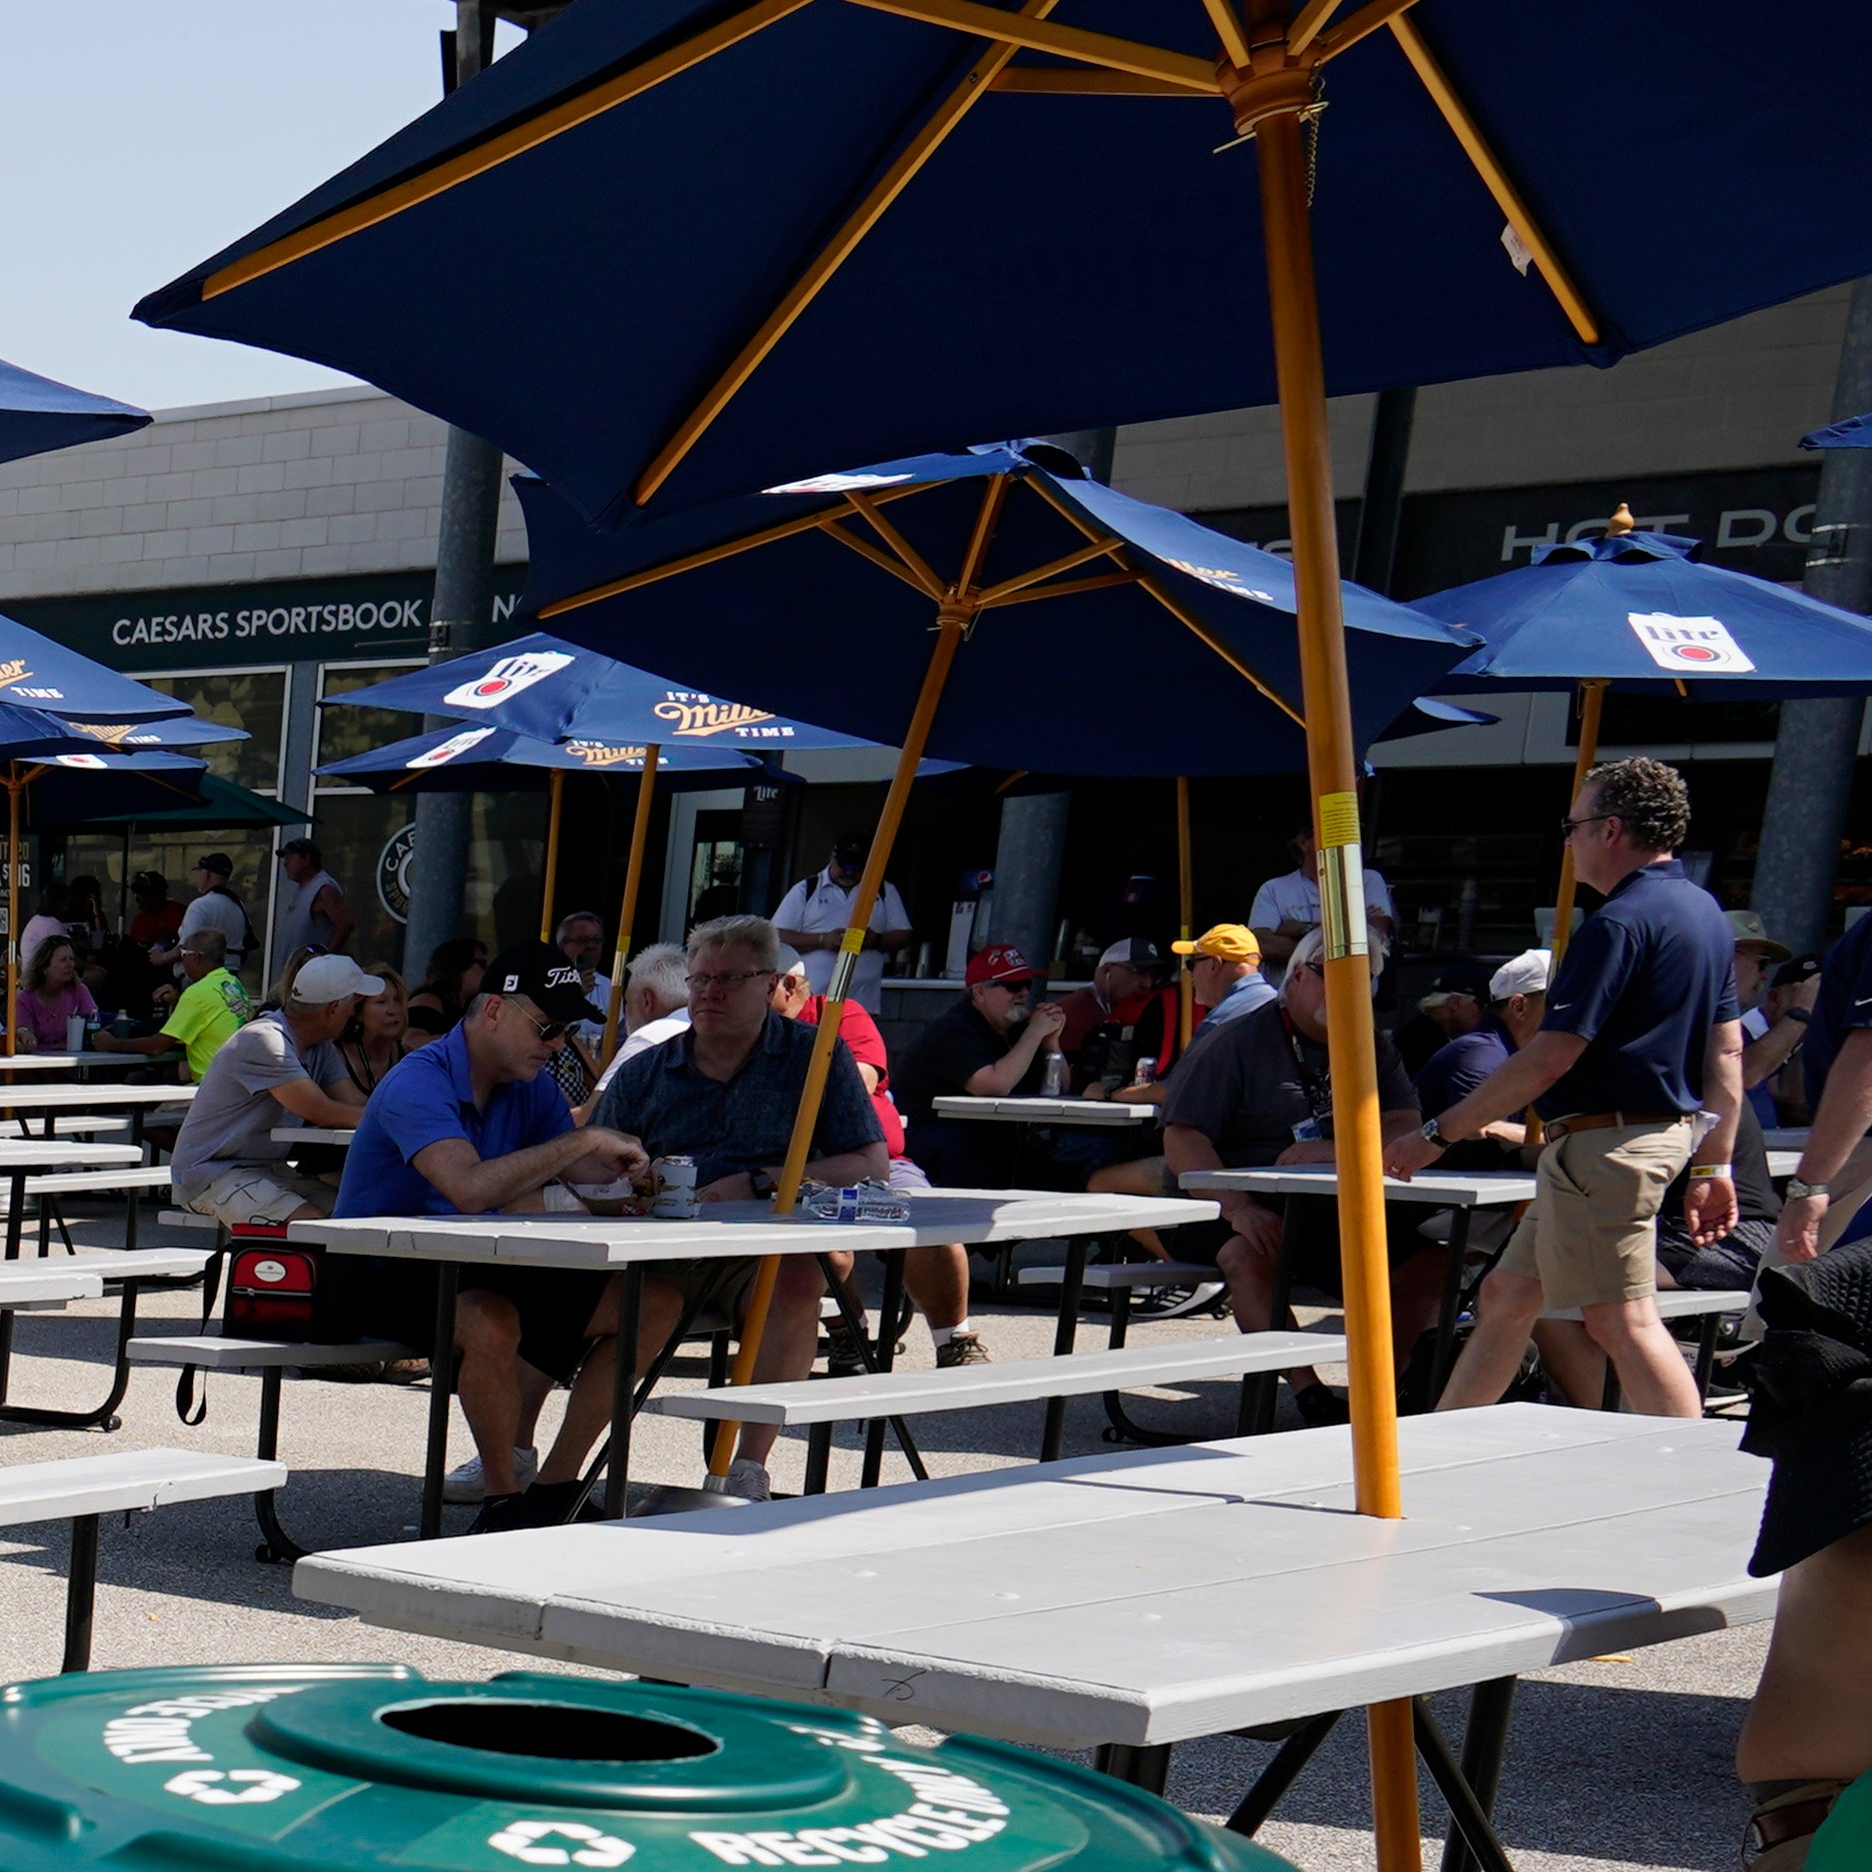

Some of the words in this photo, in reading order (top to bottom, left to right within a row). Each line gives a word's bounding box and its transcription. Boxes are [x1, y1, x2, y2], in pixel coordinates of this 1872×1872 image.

[111, 610, 230, 646] CAESARS
[235, 598, 424, 637] SPORTSBOOK
[1644, 624, 1722, 643] Lite
[10, 685, 66, 700] TIME
[665, 690, 711, 704] IT'S
[735, 725, 796, 738] TIME
[687, 1802, 1008, 1866] RECYCLE
[859, 1754, 1011, 1816] ONLY
